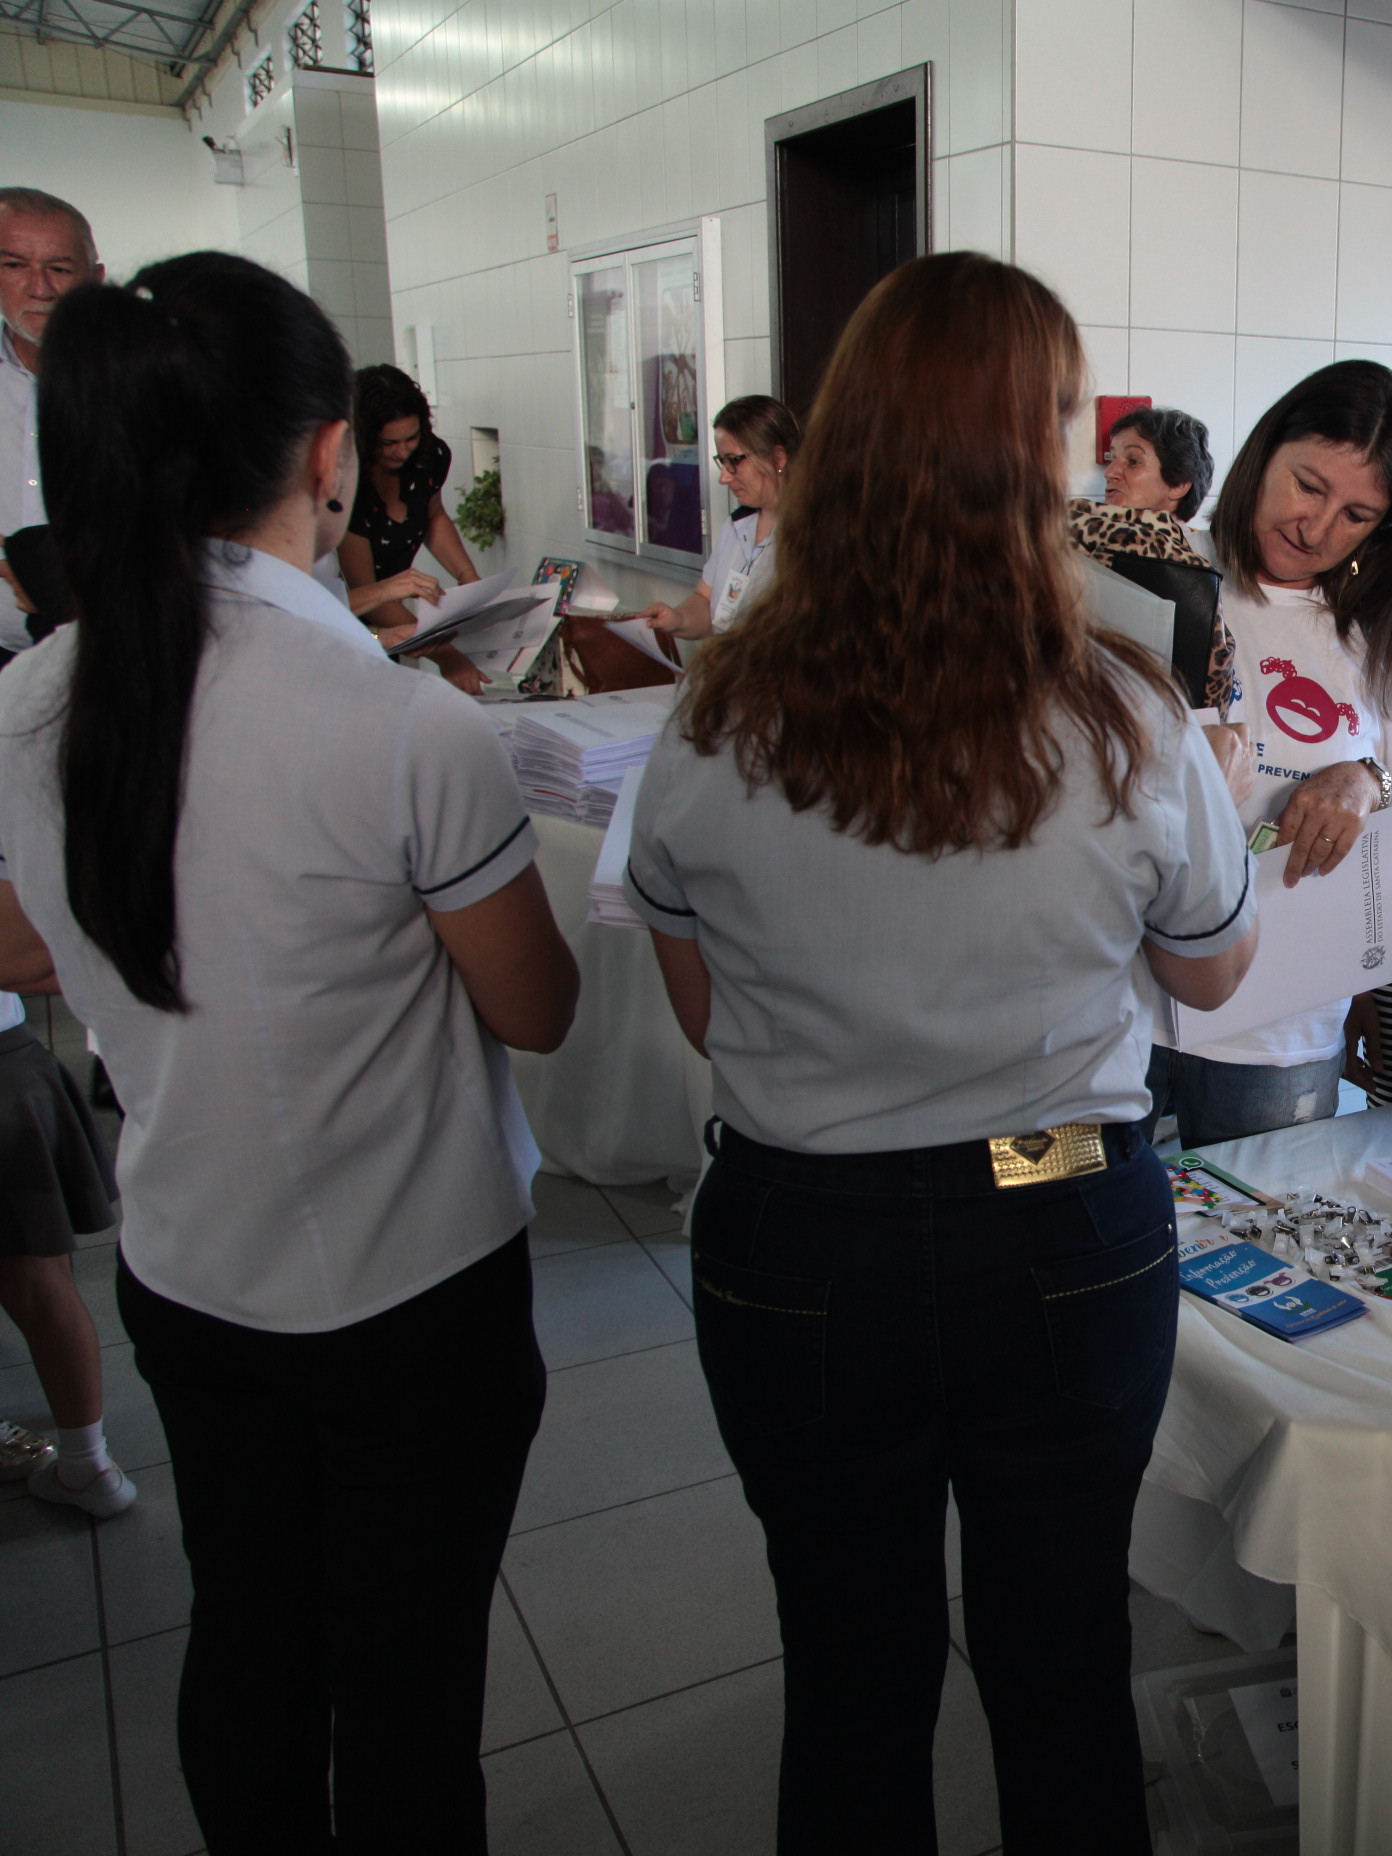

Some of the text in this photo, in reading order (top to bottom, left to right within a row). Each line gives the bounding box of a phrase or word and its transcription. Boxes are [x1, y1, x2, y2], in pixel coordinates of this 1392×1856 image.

[1258, 763, 1311, 781] PREVEN
[1362, 833, 1373, 944] ASSEMBLEIA LEGISLATIVA
[1376, 891, 1381, 901] DE
[1378, 931, 1384, 942] DO
[1178, 1239, 1215, 1258] venir
[1179, 1250, 1237, 1281] Informação
[1204, 1259, 1257, 1289] Prevenção
